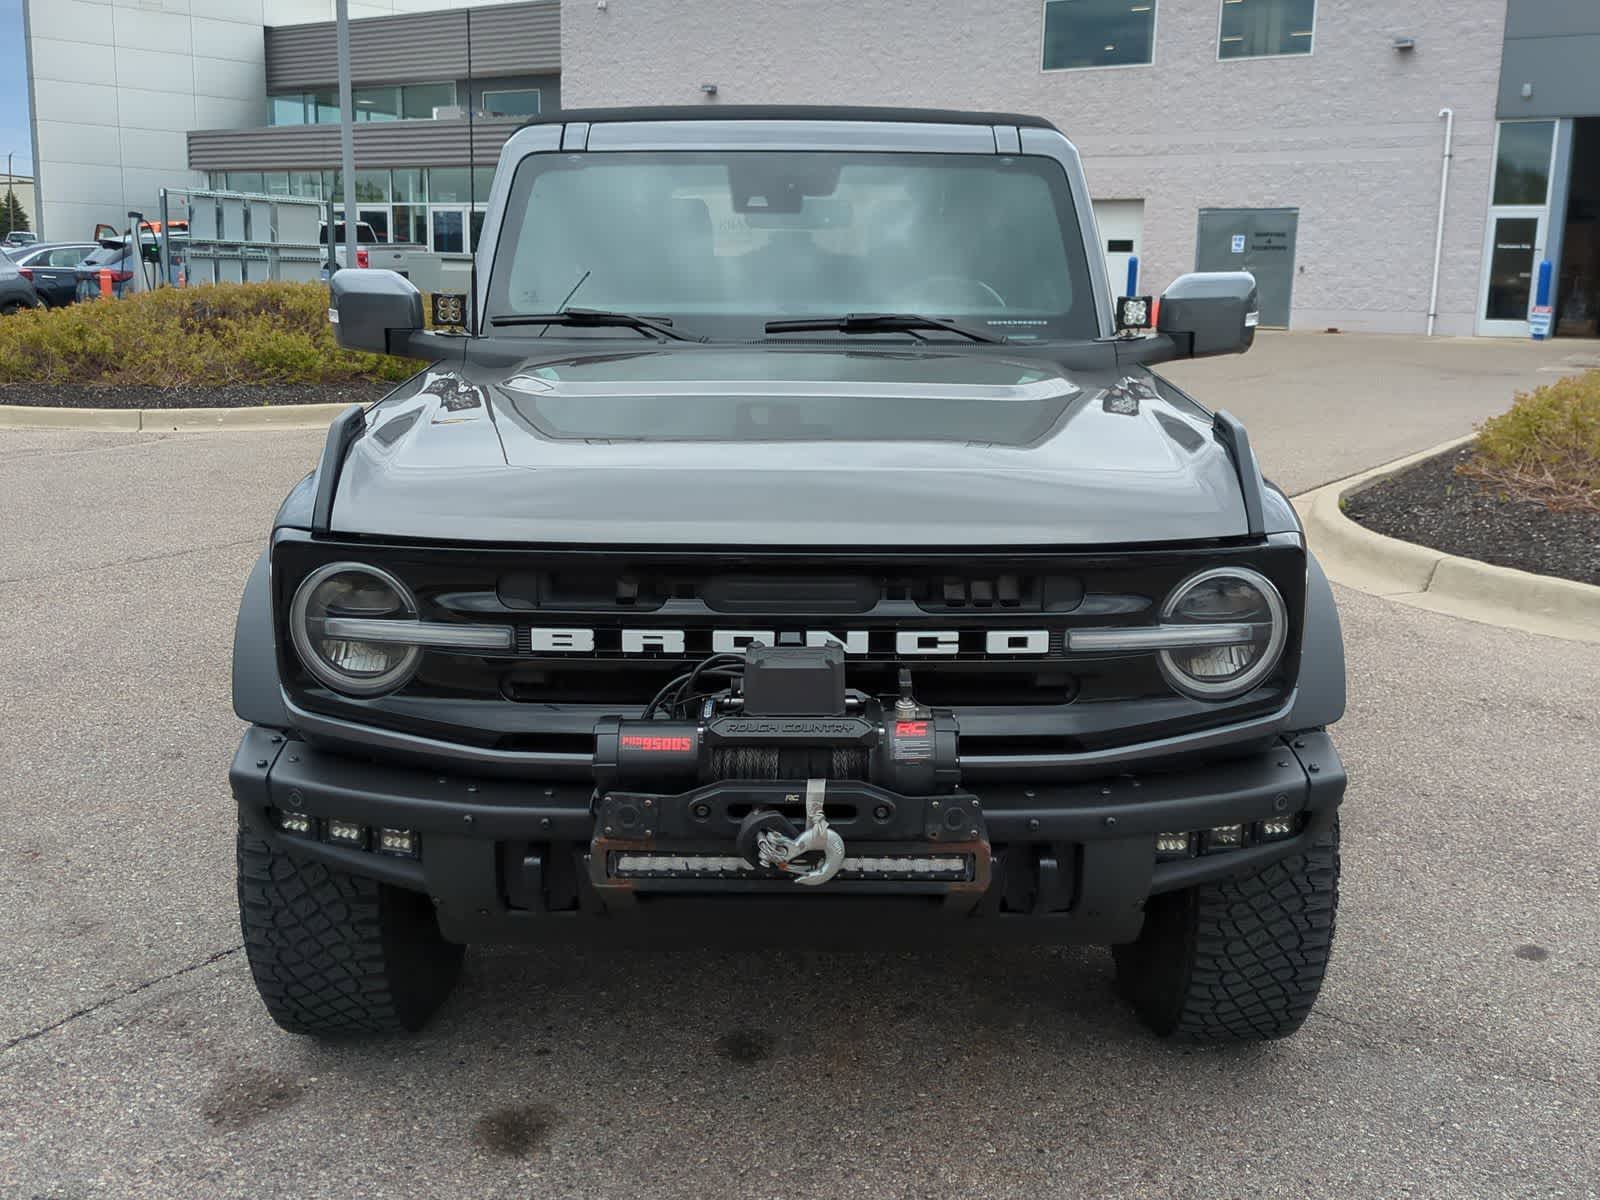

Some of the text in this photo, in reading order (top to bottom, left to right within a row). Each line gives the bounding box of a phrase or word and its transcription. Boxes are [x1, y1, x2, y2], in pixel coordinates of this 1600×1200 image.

[531, 628, 1049, 654] BRONCO
[726, 722, 855, 734] ROUGH COUNTRY
[895, 720, 929, 737] RC
